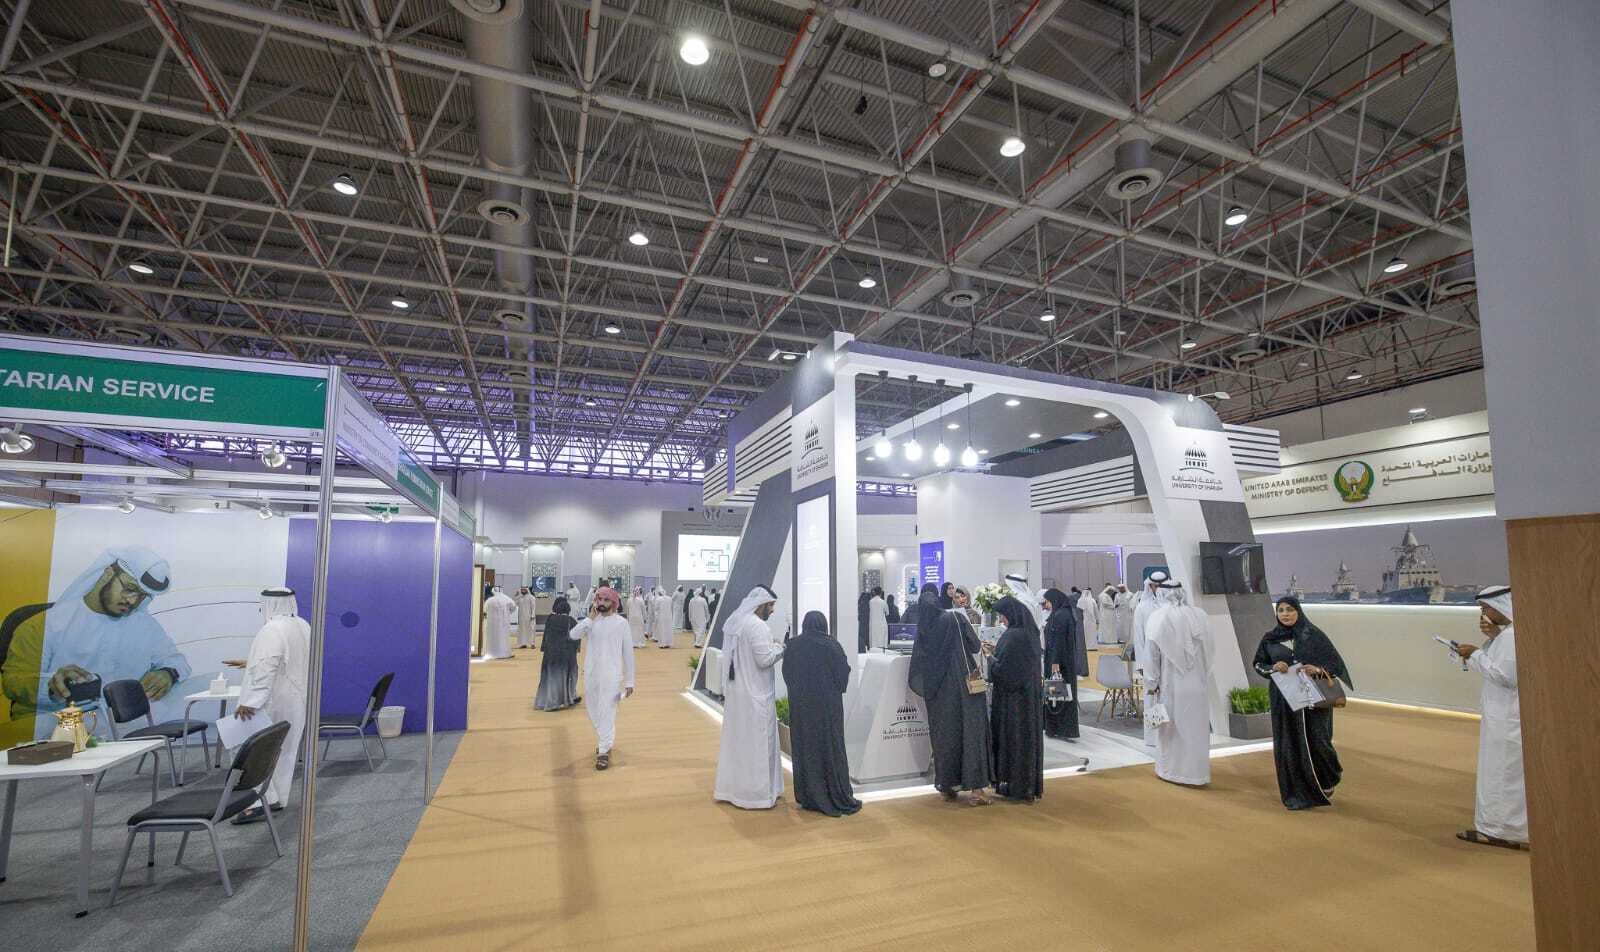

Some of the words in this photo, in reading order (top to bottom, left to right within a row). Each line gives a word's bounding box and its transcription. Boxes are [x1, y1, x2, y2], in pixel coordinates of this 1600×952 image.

[102, 378, 215, 403] SERVICE
[1381, 461, 1415, 472] المتحدة
[1417, 455, 1457, 469] العربية
[1467, 463, 1492, 474] وزارة
[1244, 482, 1270, 492] UNITED
[1271, 479, 1290, 487] ARAB
[1291, 474, 1328, 485] EMIRATES
[1251, 490, 1283, 499] MINISTRY
[1284, 488, 1294, 496] OF
[1295, 484, 1328, 495] DEFENCE
